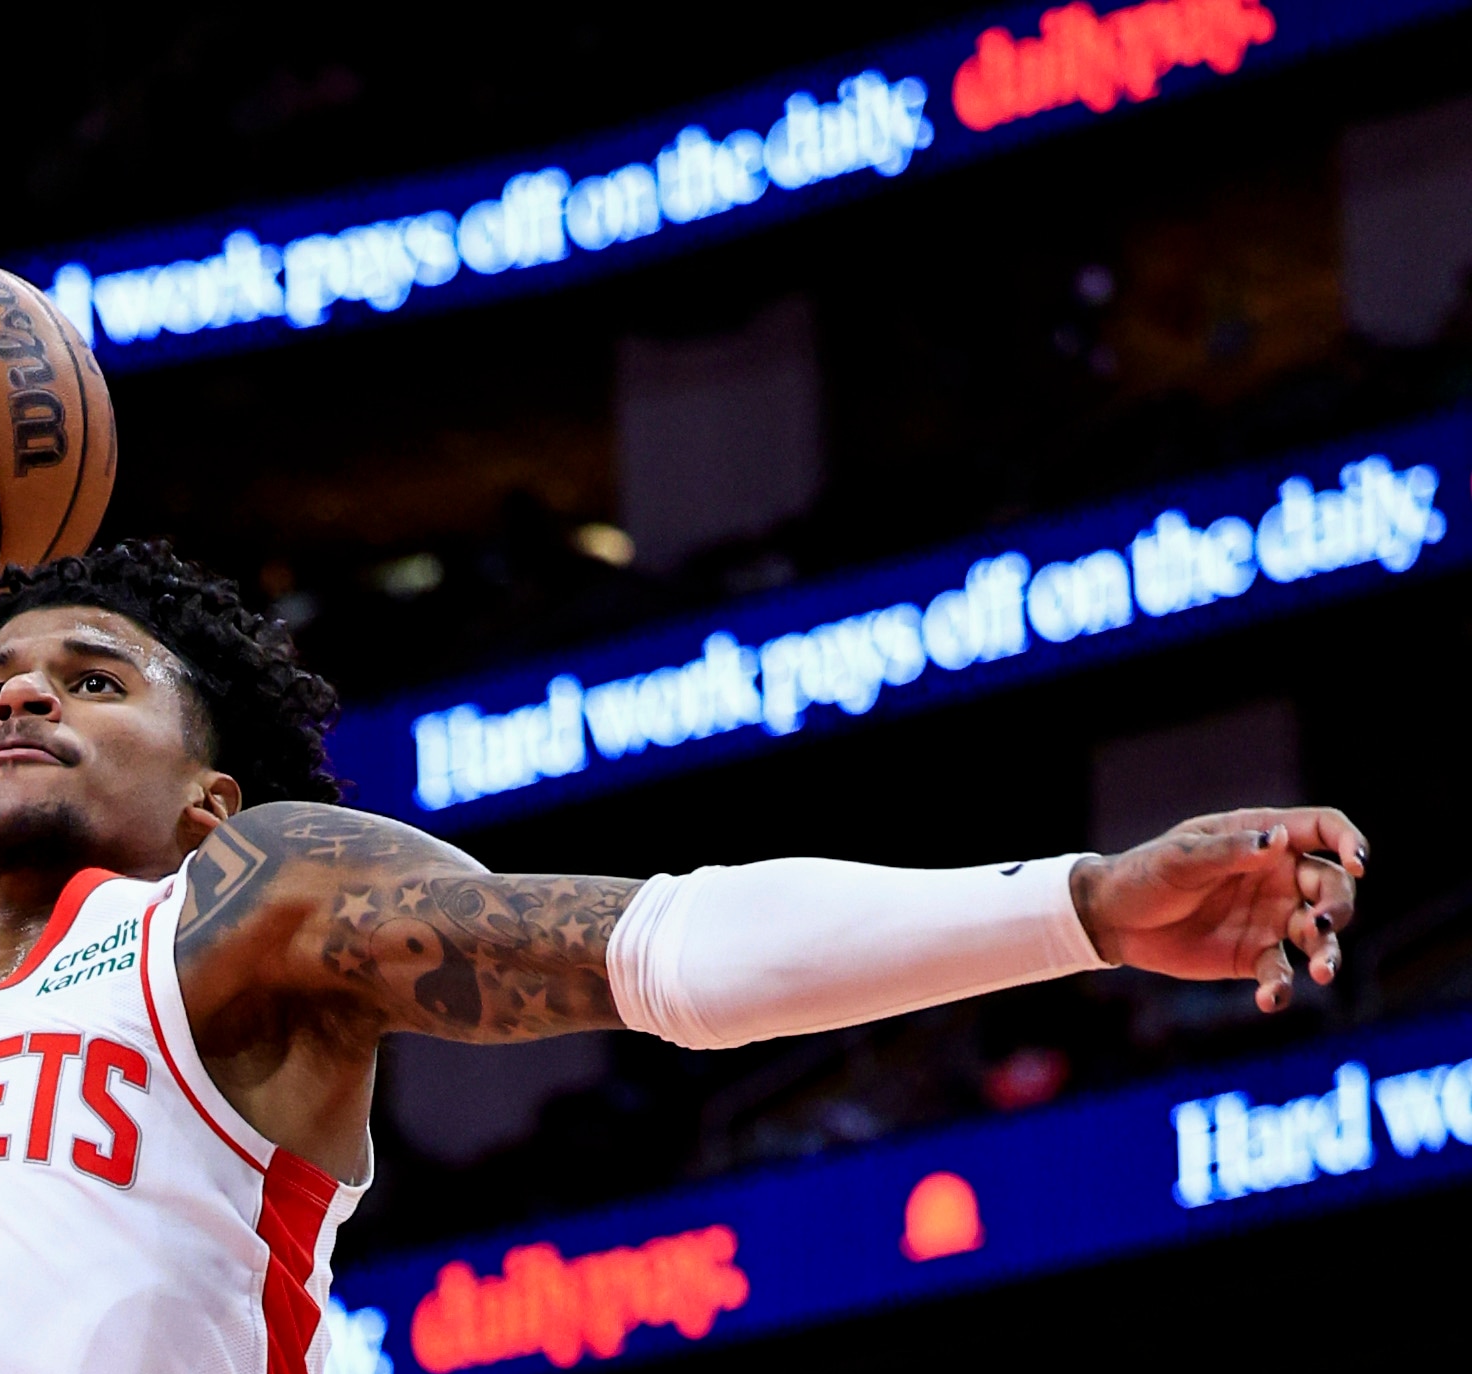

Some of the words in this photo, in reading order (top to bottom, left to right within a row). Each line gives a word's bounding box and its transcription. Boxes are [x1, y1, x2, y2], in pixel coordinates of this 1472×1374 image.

[415, 674, 586, 811] Hard
[584, 631, 762, 758] work
[759, 602, 925, 736] pays
[923, 552, 1029, 671] off
[1026, 549, 1133, 644] on
[1130, 510, 1260, 618] the
[36, 952, 135, 997] karma
[54, 918, 139, 972] credit
[1173, 1061, 1373, 1209] Hard
